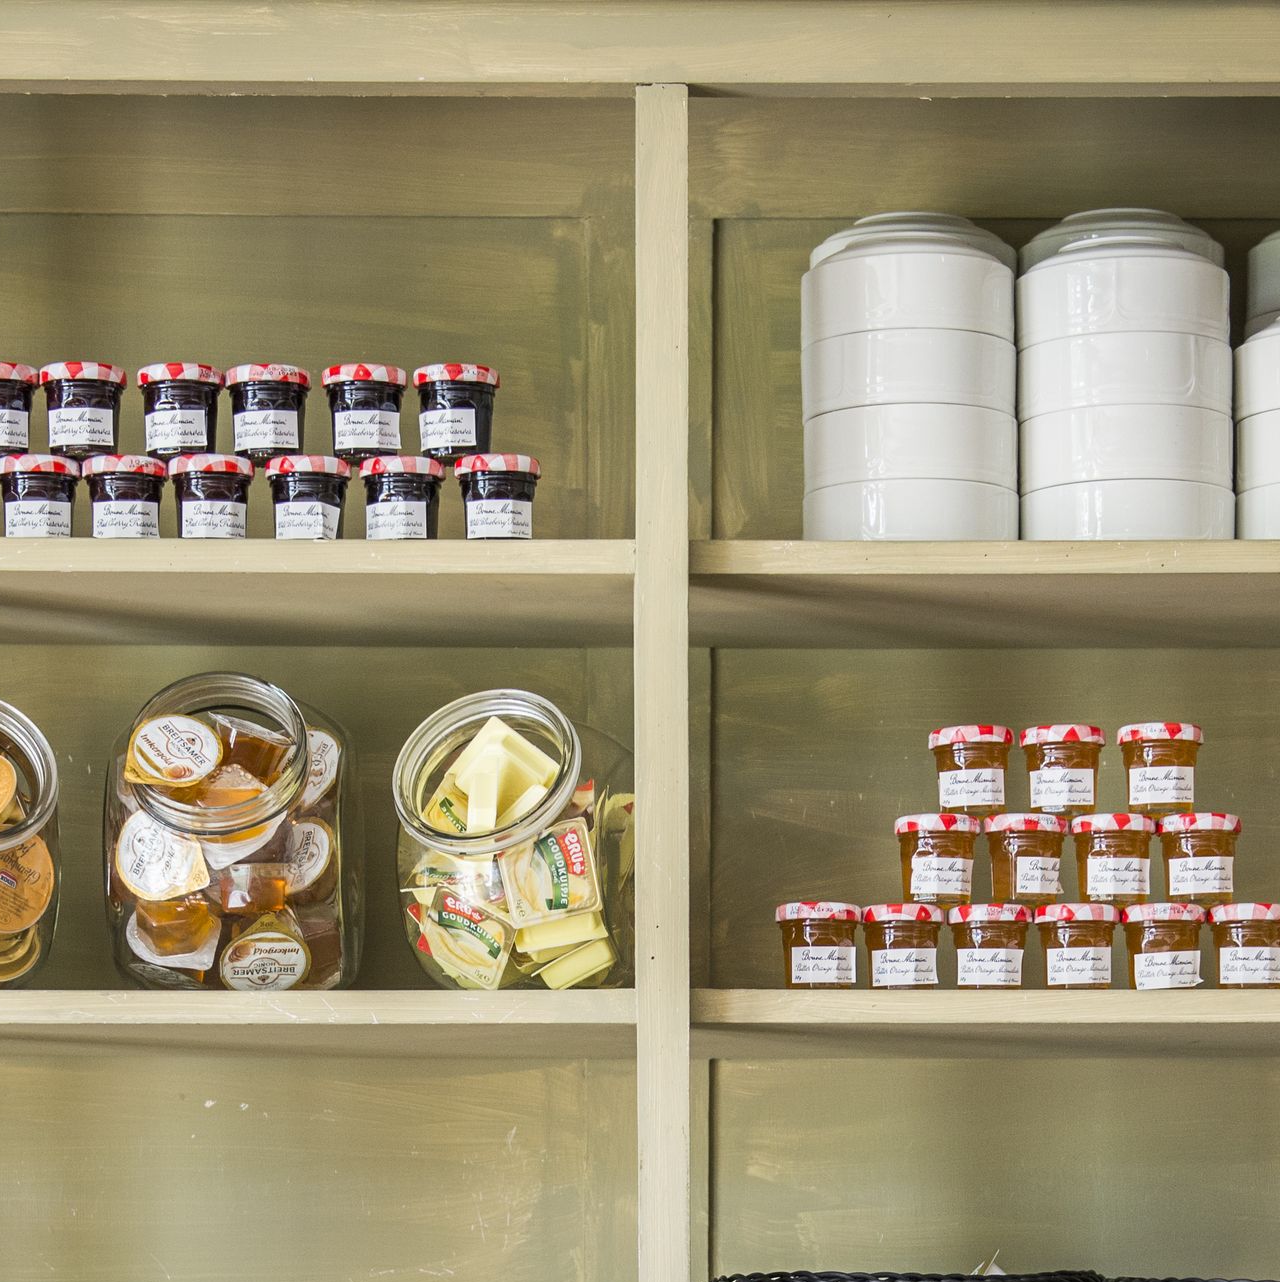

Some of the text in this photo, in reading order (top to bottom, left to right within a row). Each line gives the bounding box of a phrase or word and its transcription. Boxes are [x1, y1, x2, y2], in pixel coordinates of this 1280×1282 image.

[140, 733, 175, 766] Imkergold
[161, 722, 206, 766] BREITSAMER
[546, 836, 570, 906] GOUDKUIPJE
[442, 910, 501, 951] GOUDKUIPJE
[253, 946, 300, 956] Imkergold
[232, 966, 296, 977] BREITSAMER
